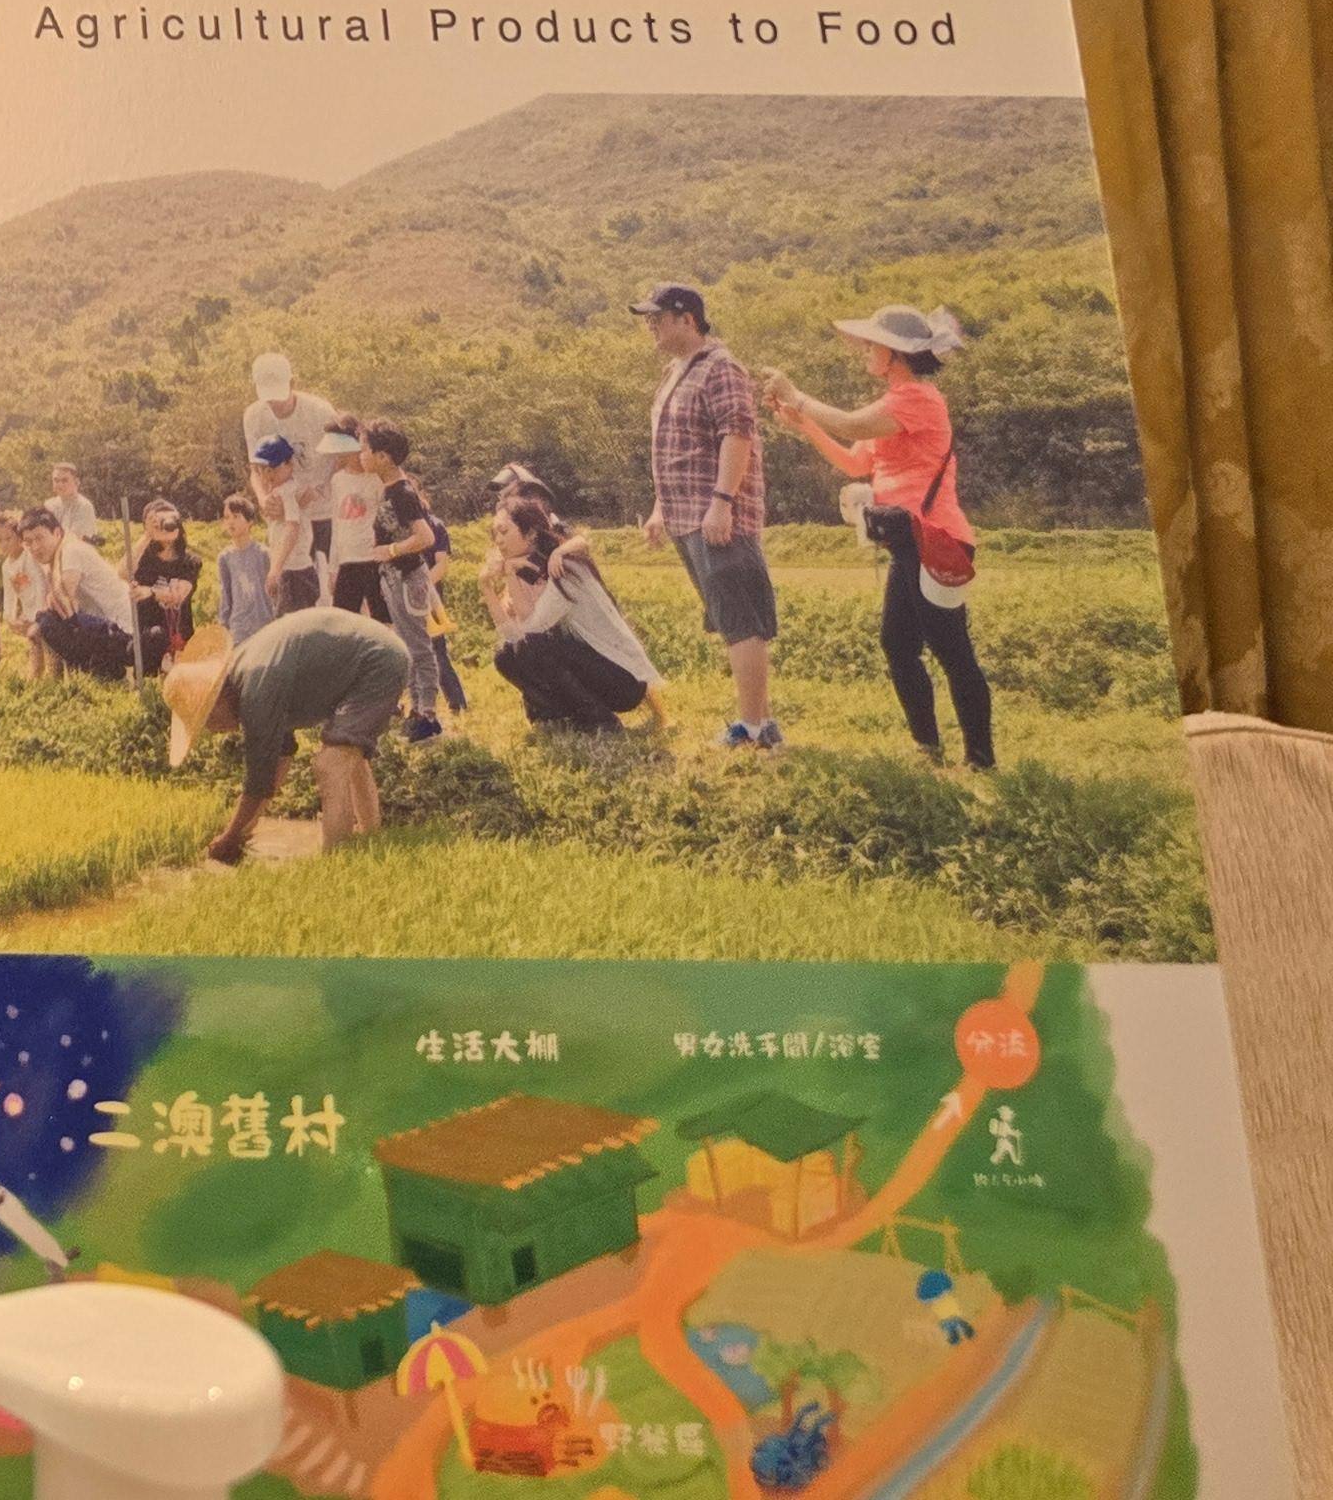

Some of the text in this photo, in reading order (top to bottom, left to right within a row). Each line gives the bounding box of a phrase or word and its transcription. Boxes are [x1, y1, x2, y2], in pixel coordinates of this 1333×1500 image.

[35, 6, 392, 49] Agricultural
[431, 8, 693, 45] Products
[730, 12, 779, 44] to
[818, 10, 957, 46] Food
[88, 1091, 345, 1159] 二澳舊村
